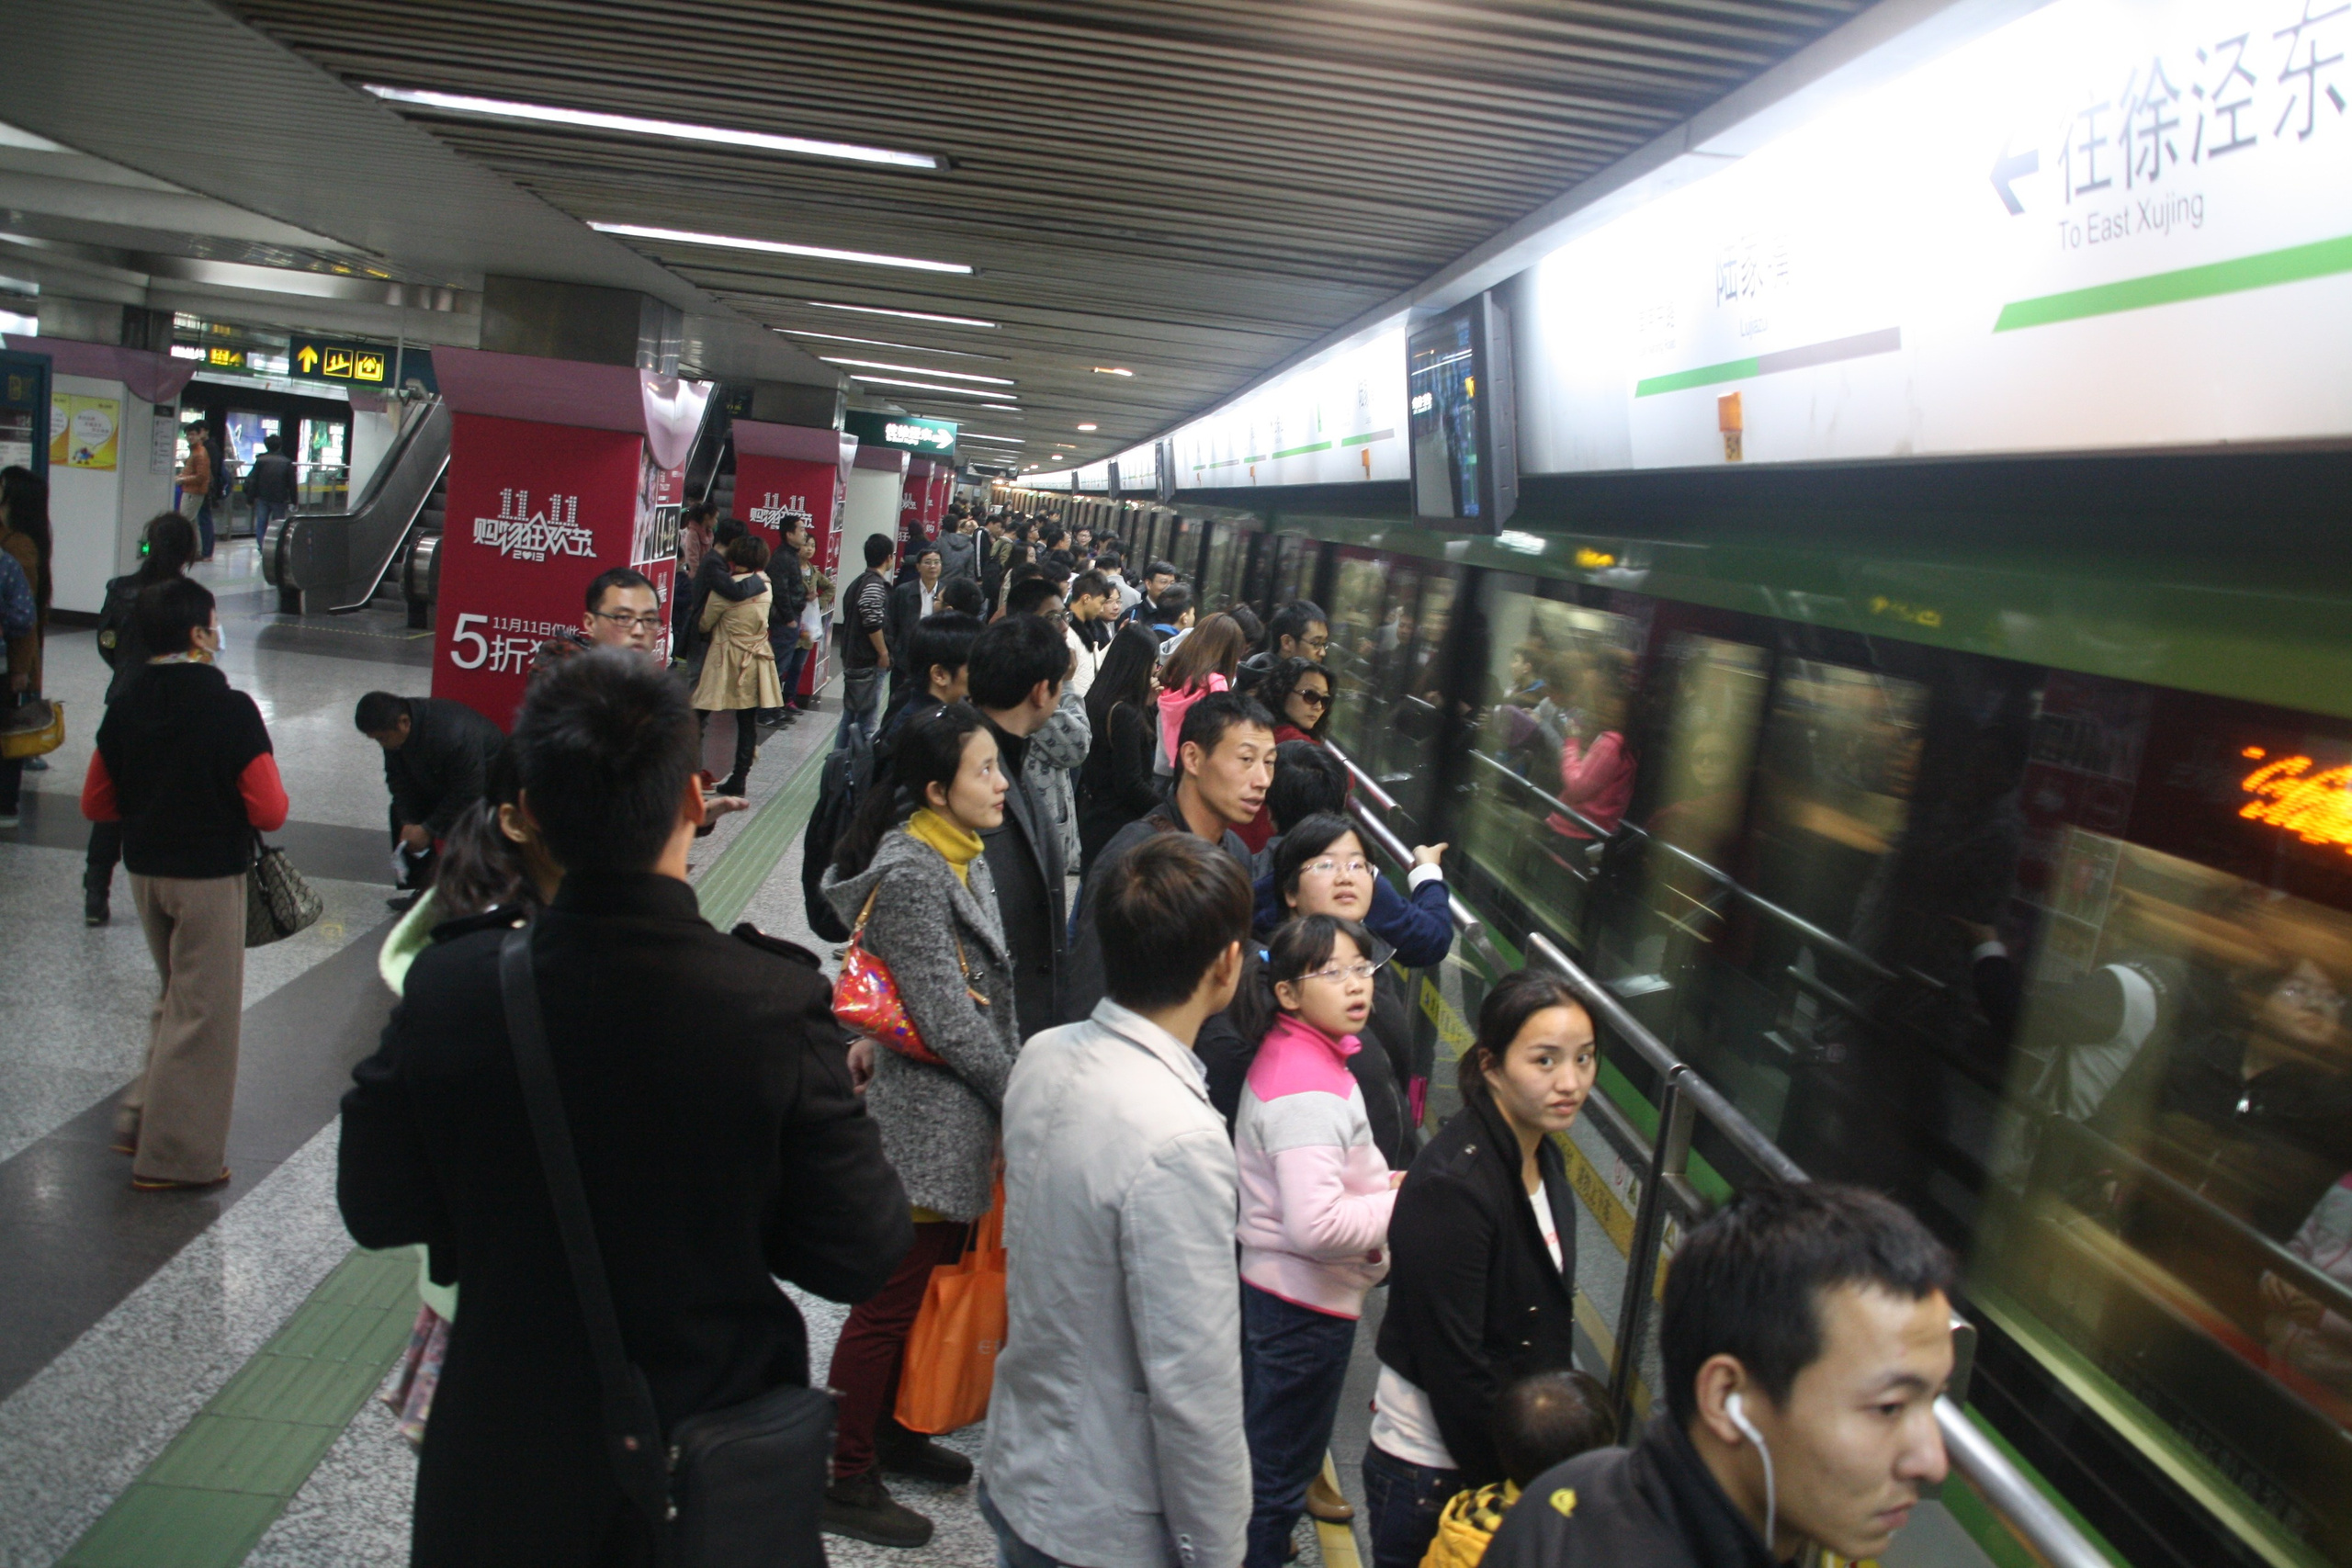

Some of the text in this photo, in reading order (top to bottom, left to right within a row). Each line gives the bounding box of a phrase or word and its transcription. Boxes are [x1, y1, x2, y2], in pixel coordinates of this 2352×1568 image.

[2057, 0, 2352, 205] 往徐泾东
[2058, 191, 2205, 251] To East Xujing
[473, 511, 597, 558] 购物狂欢节
